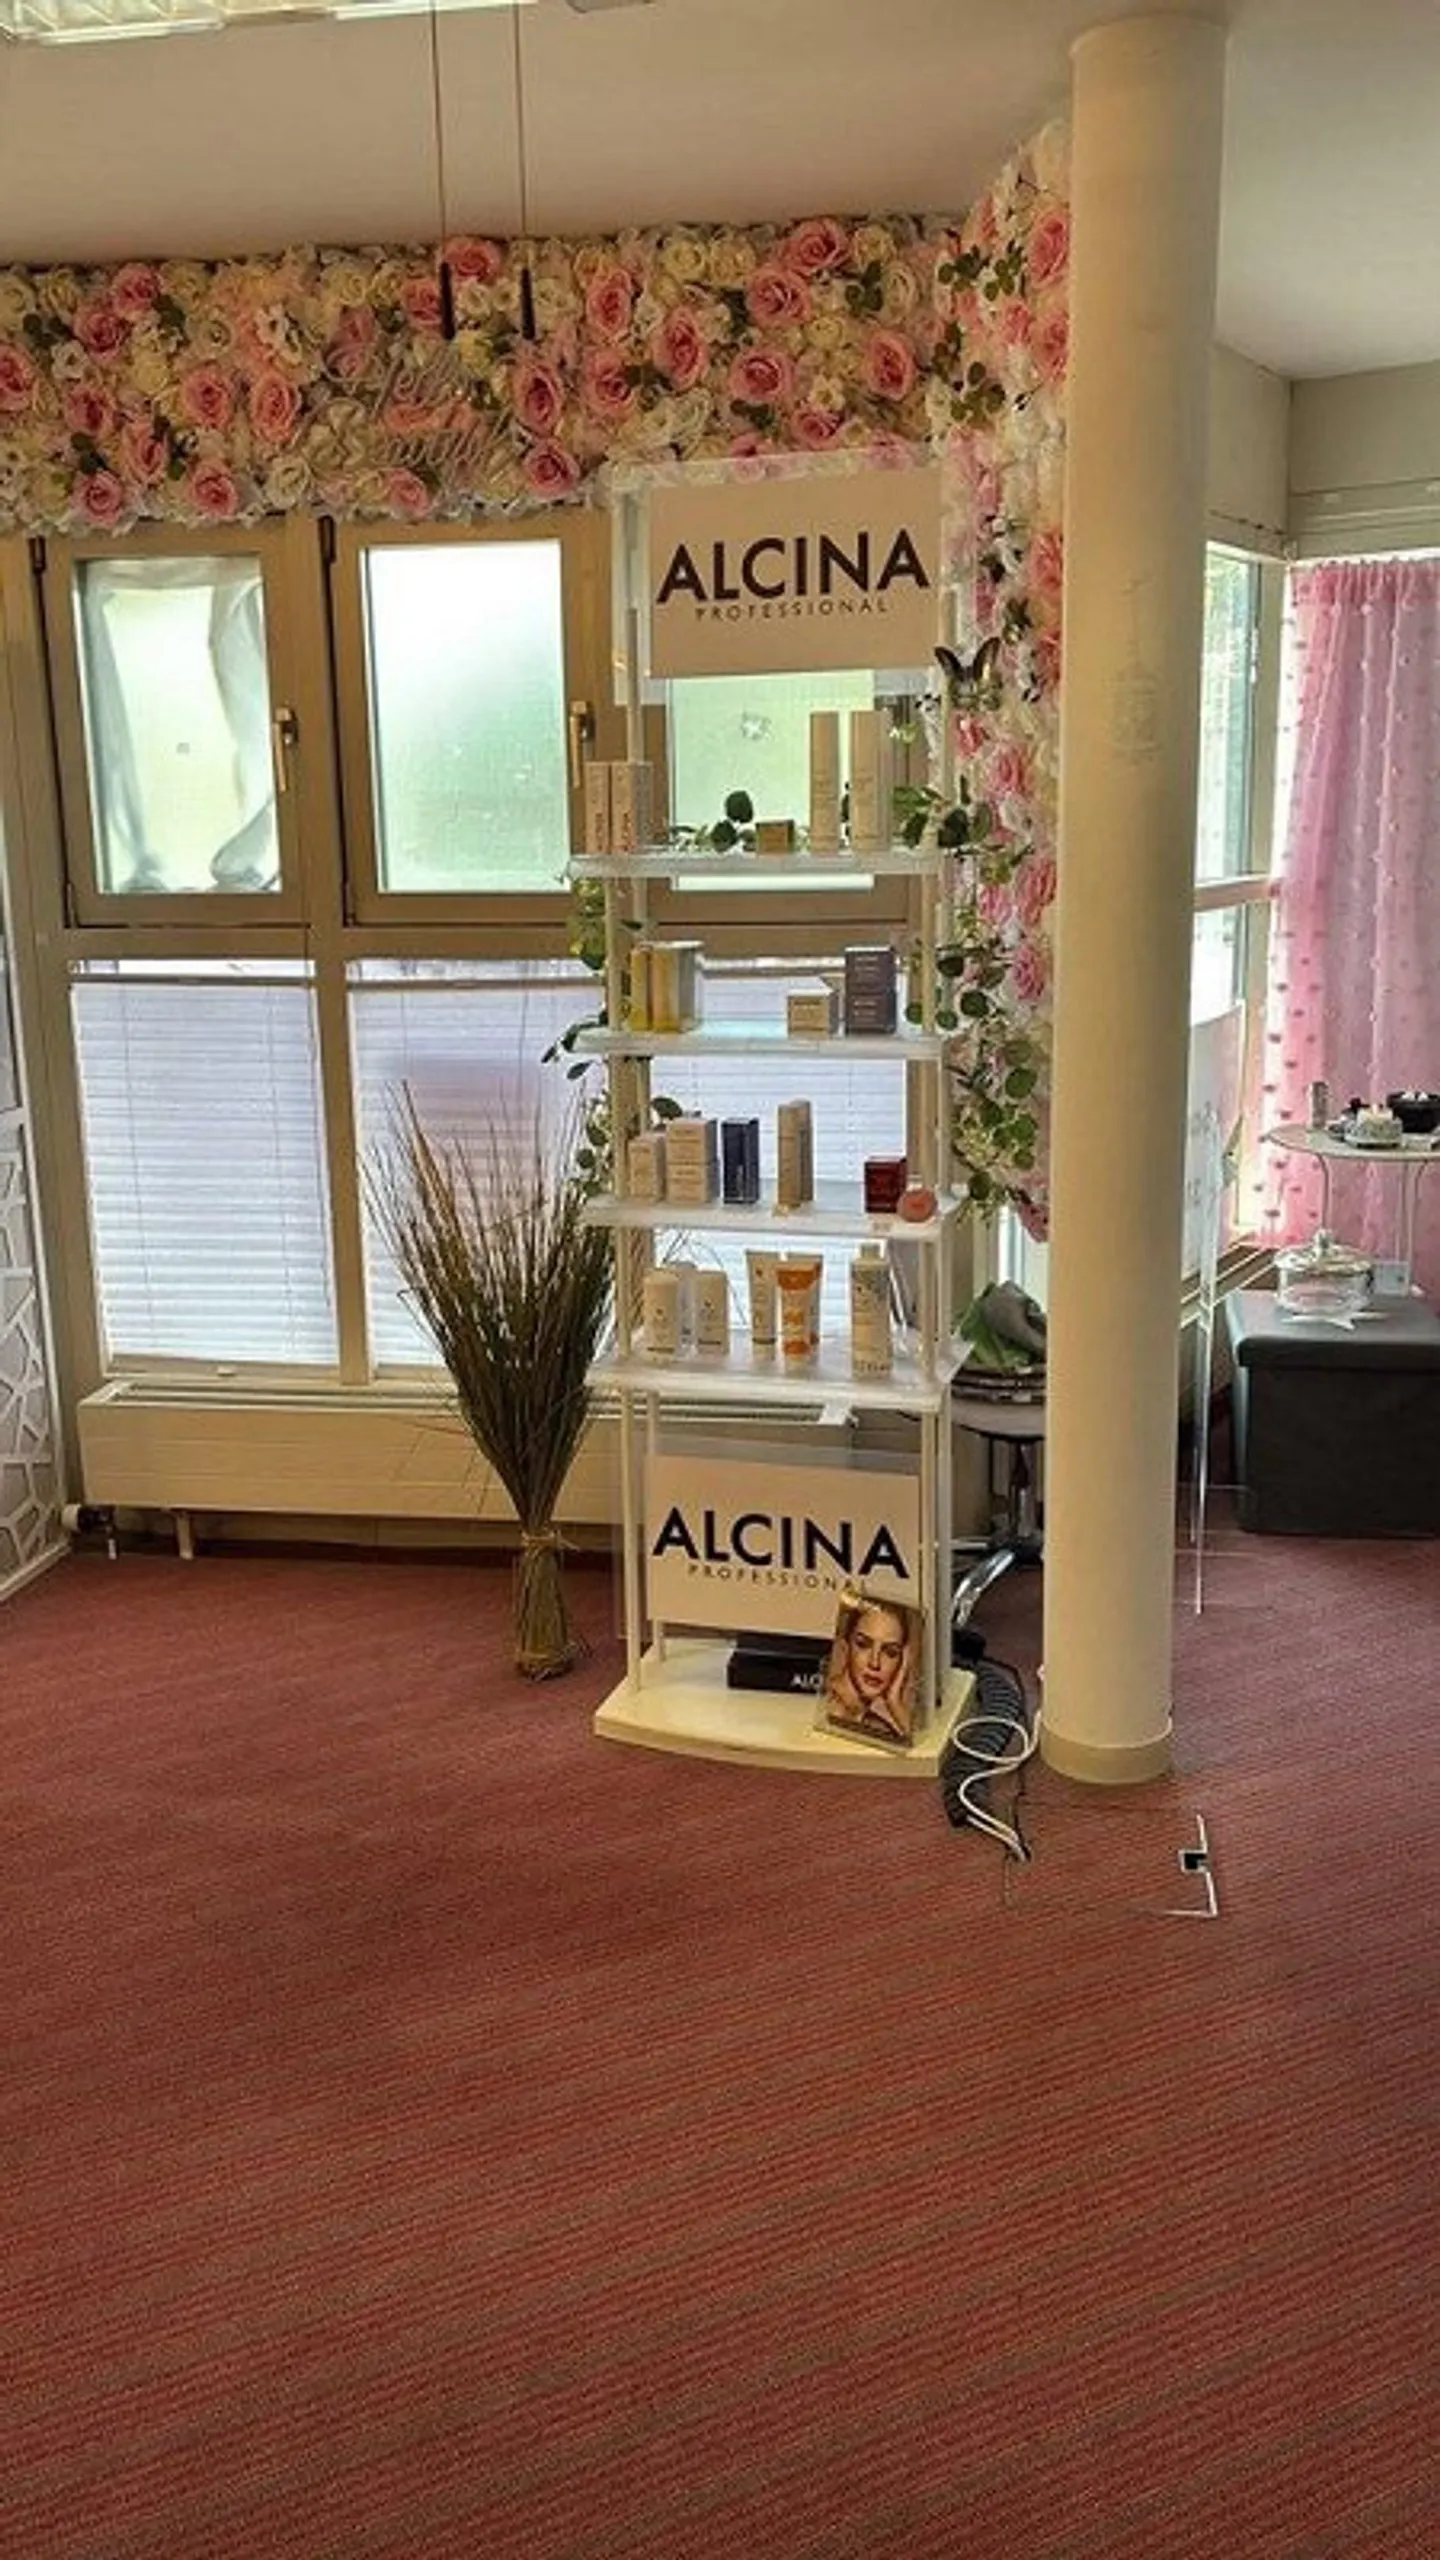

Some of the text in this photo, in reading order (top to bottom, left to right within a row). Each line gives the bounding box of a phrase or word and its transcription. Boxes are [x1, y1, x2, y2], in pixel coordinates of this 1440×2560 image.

[656, 528, 930, 604] ALCINA
[694, 598, 887, 622] PROFESSIONAL
[652, 1506, 910, 1579] ALCINA
